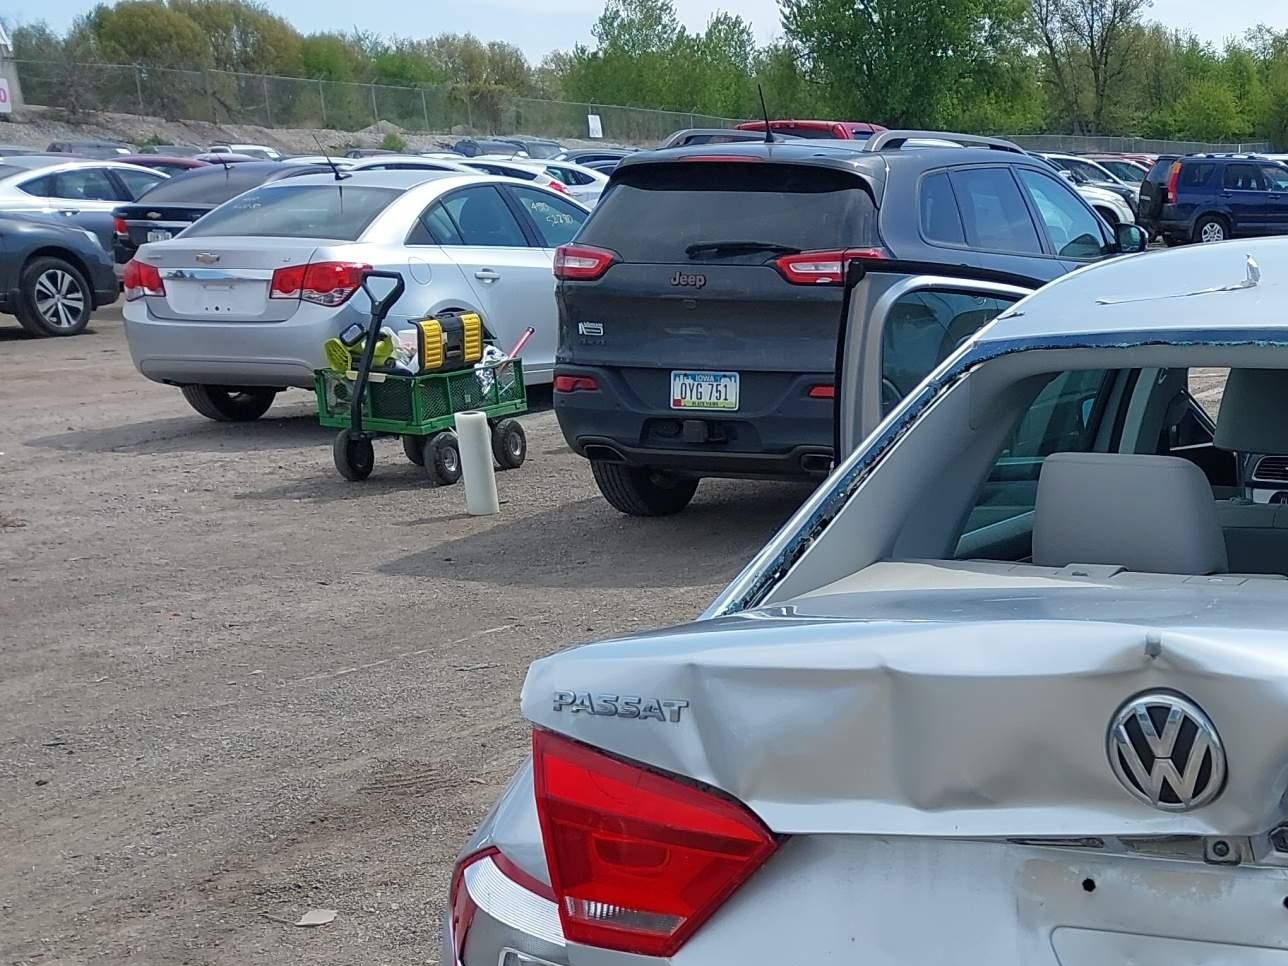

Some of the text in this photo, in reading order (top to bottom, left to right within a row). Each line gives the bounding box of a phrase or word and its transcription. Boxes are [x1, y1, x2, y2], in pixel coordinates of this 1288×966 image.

[670, 271, 706, 288] Jeep
[696, 374, 715, 382] IOWA
[708, 383, 729, 401] 751
[552, 689, 690, 723] PASSAT
